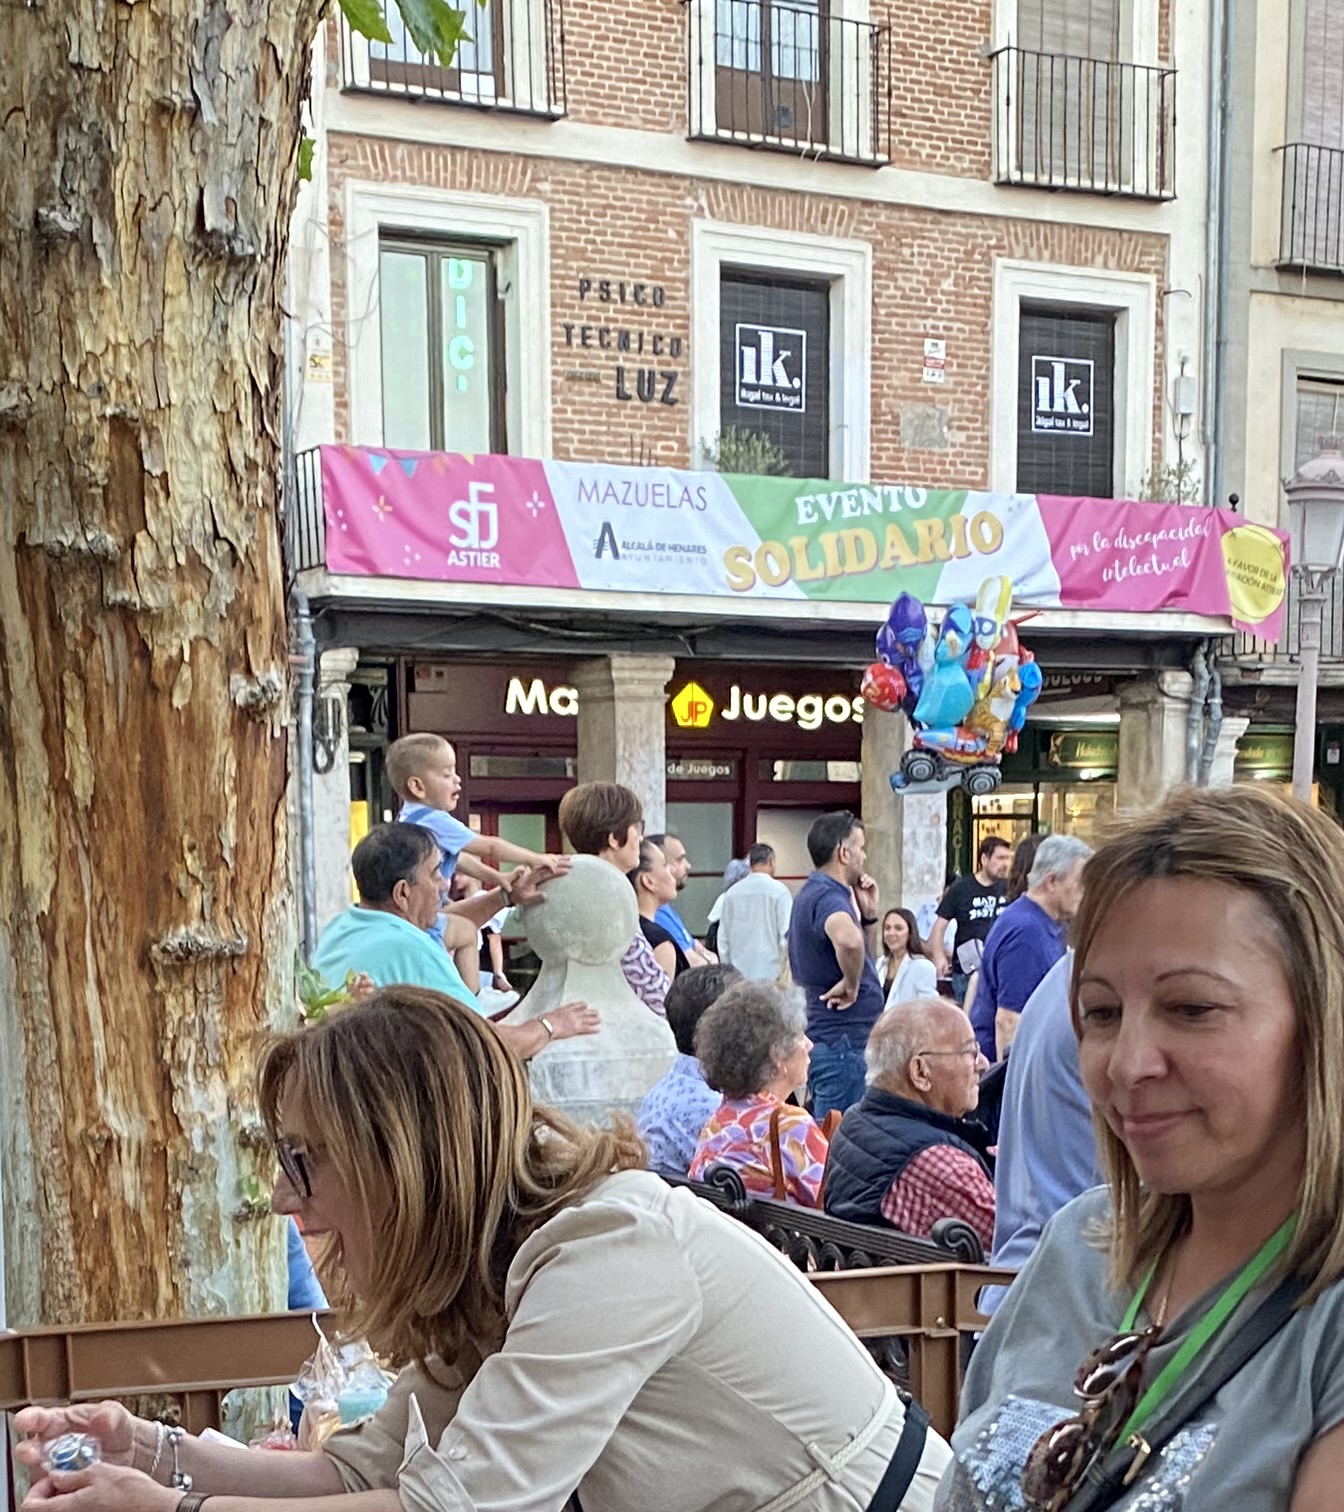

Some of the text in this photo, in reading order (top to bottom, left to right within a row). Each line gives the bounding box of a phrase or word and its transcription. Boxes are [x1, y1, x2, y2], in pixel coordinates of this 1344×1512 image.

[578, 278, 665, 308] PSICO
[562, 321, 683, 359] TECNICO
[615, 365, 679, 406] LUZ
[577, 478, 708, 512] MAZUELAS
[795, 485, 929, 525] EVENTO
[668, 544, 708, 555] HENARES
[722, 510, 1005, 592] SOLIDARIO
[1093, 530, 1112, 552] la
[447, 549, 501, 569] ASTIER
[667, 763, 731, 776] de Juegos
